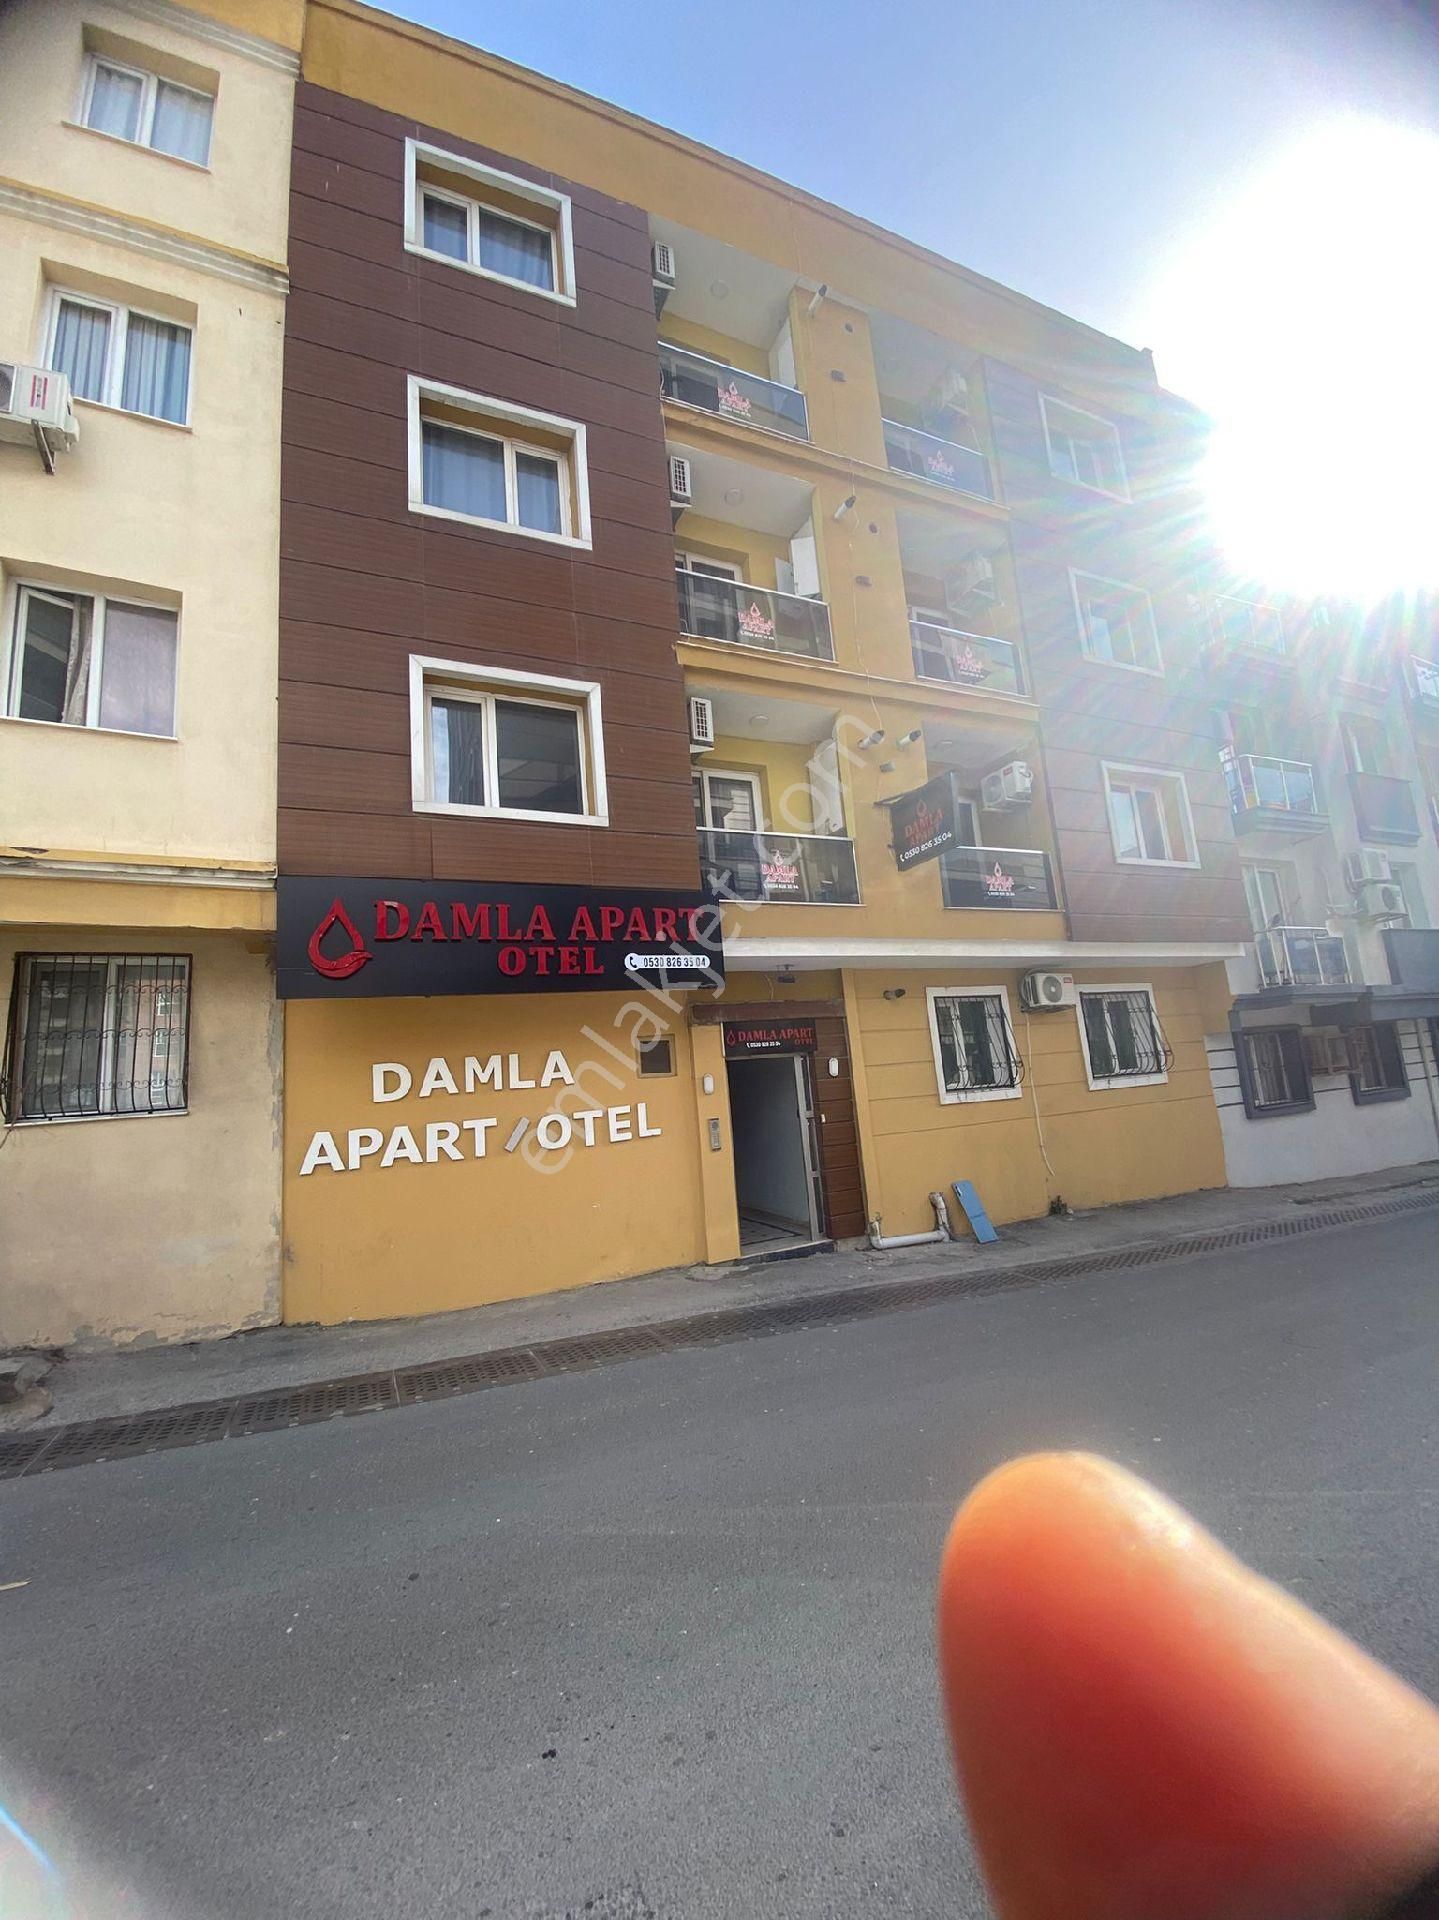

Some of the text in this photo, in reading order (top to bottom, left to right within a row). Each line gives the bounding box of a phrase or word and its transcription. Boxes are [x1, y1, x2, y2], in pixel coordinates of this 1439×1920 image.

[374, 900, 705, 943] DAMLA APART
[498, 946, 605, 975] OTEL
[643, 957, 706, 967] 0530 826 35 04
[737, 1027, 814, 1042] DAMLA APART
[373, 1050, 575, 1103] DAMLA
[300, 1117, 498, 1175] APART
[537, 1102, 662, 1151] OTEL
